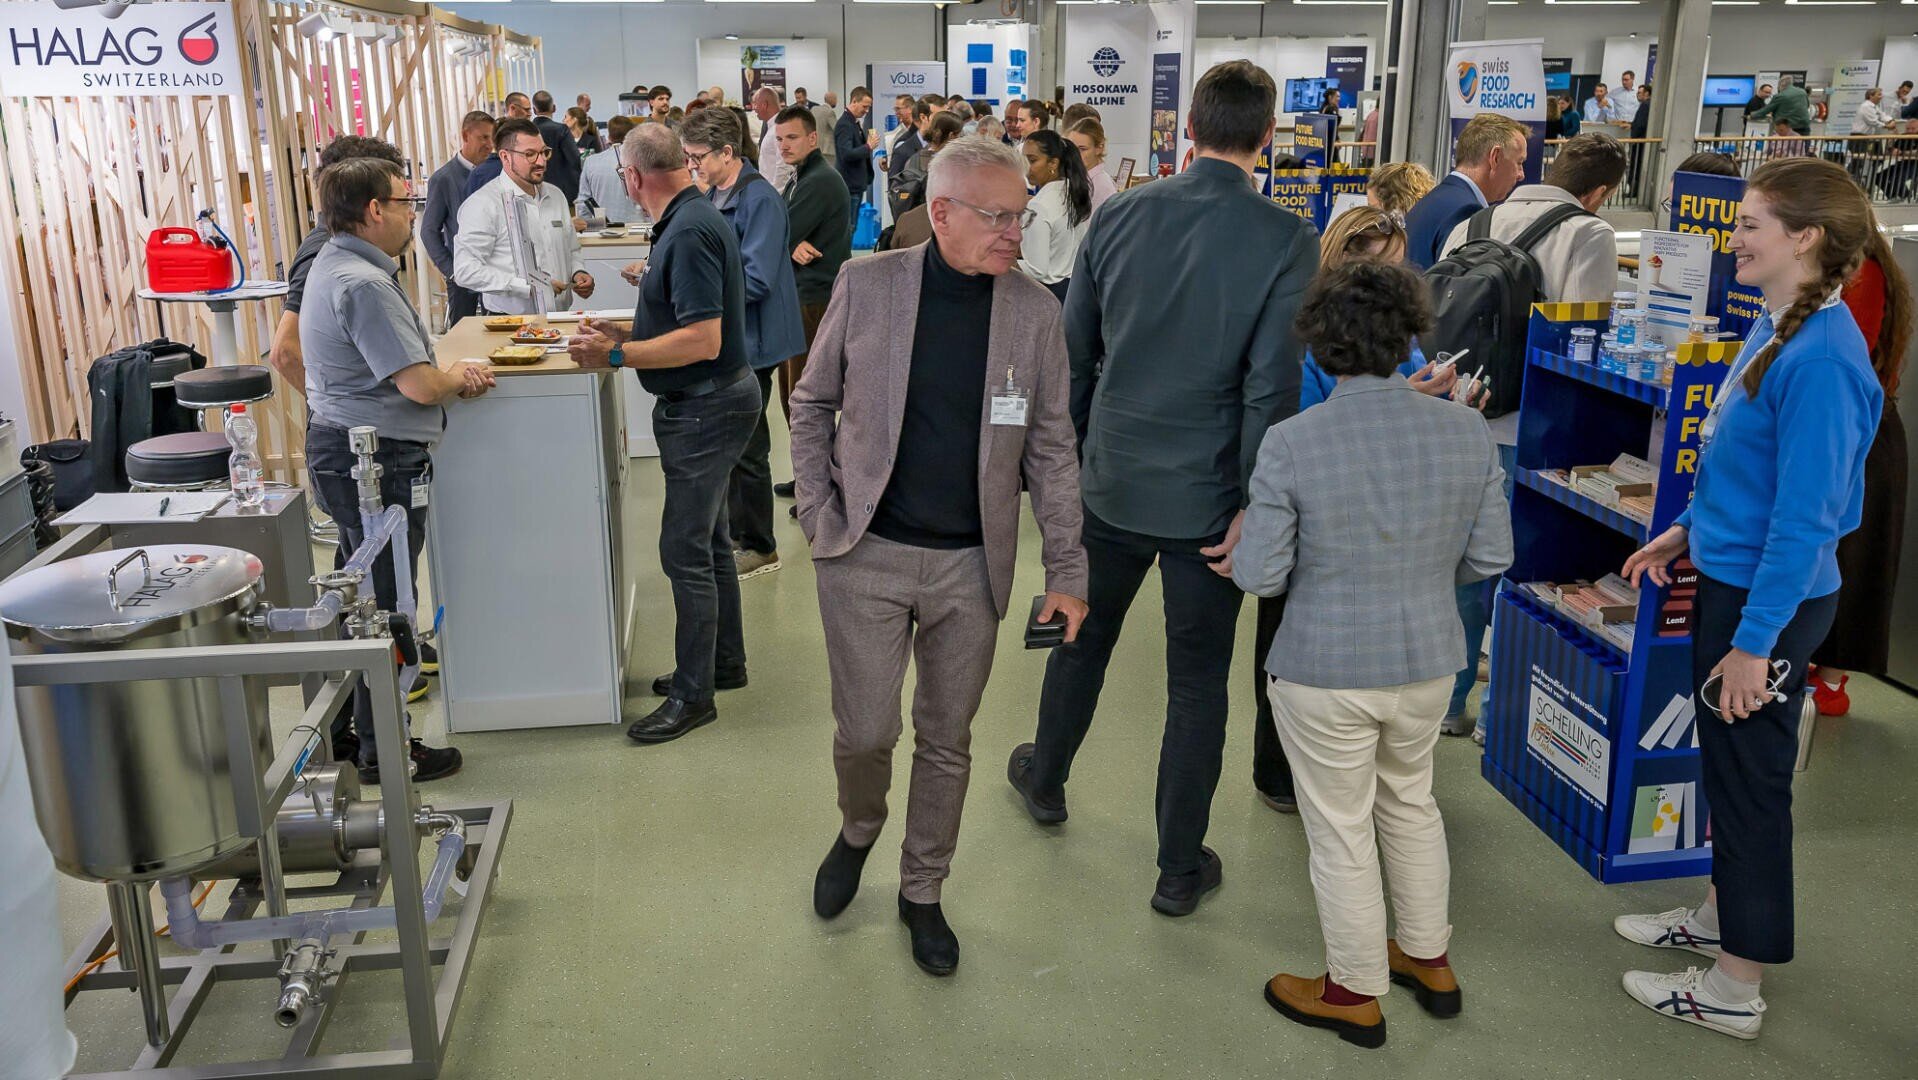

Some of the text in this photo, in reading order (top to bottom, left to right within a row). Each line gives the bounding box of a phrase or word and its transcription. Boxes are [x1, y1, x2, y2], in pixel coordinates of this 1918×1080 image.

[9, 26, 163, 66] HALAG
[83, 73, 224, 87] SWITZERLAND
[1481, 75, 1510, 91] FOOD
[1073, 84, 1138, 94] HOSOKAWA
[1086, 96, 1126, 106] ALPINE
[1480, 93, 1536, 110] RESEARCH
[1257, 154, 1269, 169] AIL
[1274, 183, 1322, 195] FUTURE
[1332, 183, 1364, 193] FUTU
[1273, 195, 1307, 207] FOOD
[1679, 194, 1741, 225] FUTU
[1727, 291, 1764, 306] powered
[1727, 303, 1751, 319] Swiss
[1536, 696, 1602, 759] SCHELLING
